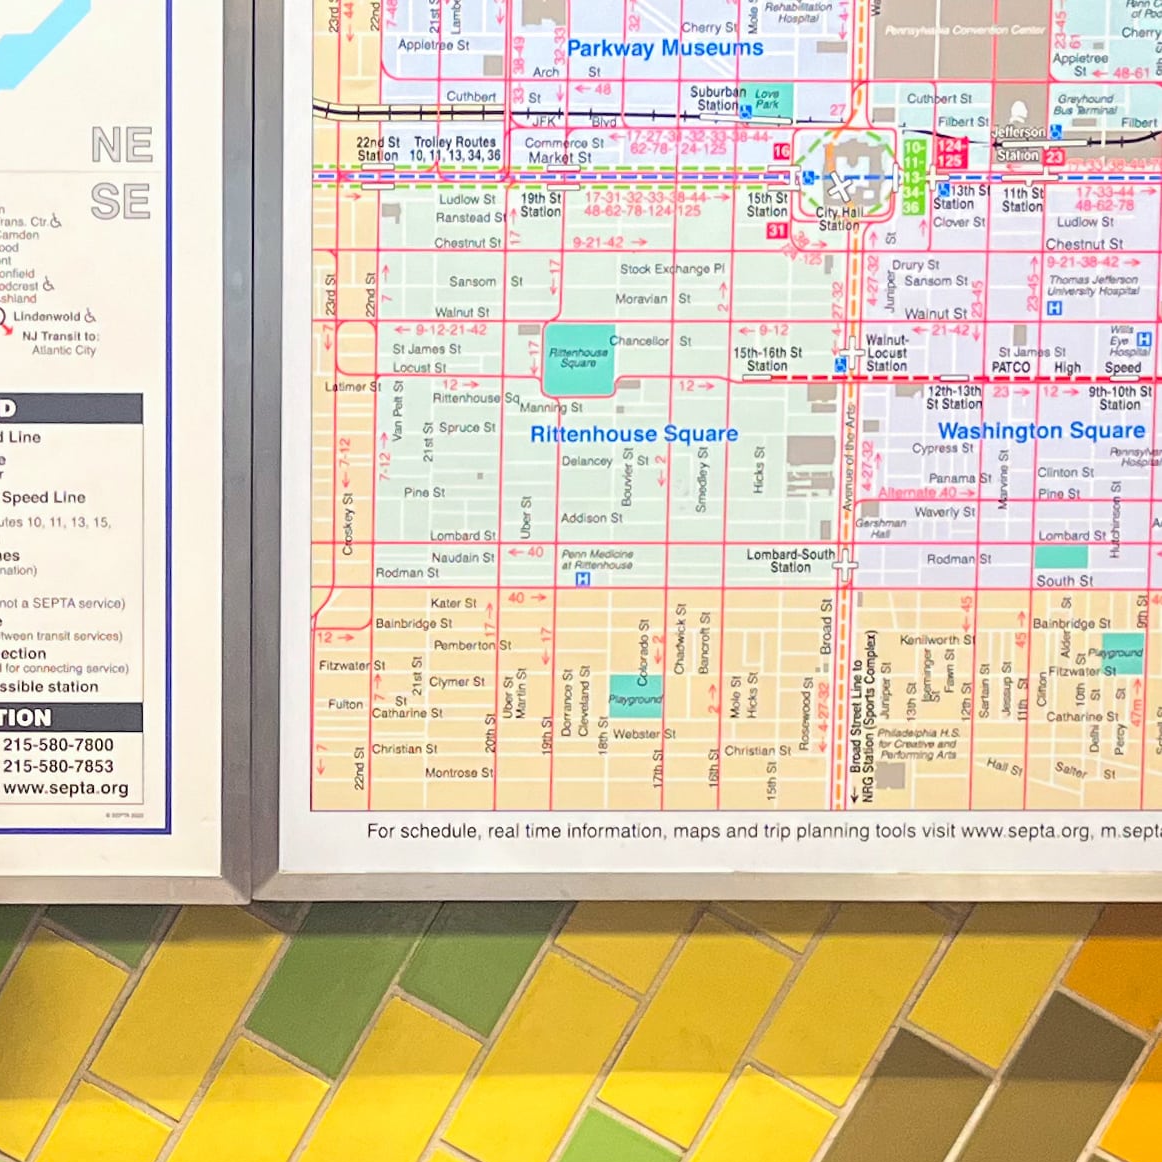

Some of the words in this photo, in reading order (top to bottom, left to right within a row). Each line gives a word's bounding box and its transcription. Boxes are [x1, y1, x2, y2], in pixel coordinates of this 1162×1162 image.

[568, 38, 655, 58] Parkway
[661, 38, 764, 56] Museums
[91, 126, 153, 163] NE
[357, 137, 384, 148] 22nd
[388, 136, 400, 148] St
[414, 135, 452, 151] Trolley
[456, 136, 496, 148] Routes
[358, 150, 398, 161] Station
[410, 149, 425, 162] 10,
[430, 149, 445, 162] 11,
[449, 149, 465, 162] 13,
[468, 149, 484, 162] 34,
[488, 149, 500, 161] 36
[775, 143, 792, 158] 16
[90, 182, 151, 220] SE
[522, 192, 545, 204] 19th
[550, 192, 561, 204] St
[748, 191, 772, 204] 15th
[775, 191, 787, 204] St
[521, 205, 561, 217] Station
[747, 205, 787, 217] Station
[814, 205, 838, 220] City
[842, 207, 864, 218] Hall
[819, 219, 859, 231] Station
[14, 312, 80, 321] Lindenwold
[23, 331, 37, 341] NJ
[41, 331, 80, 341] Transit
[84, 331, 101, 342] to:
[734, 347, 786, 358] 15th-16th
[790, 346, 802, 358] St
[748, 360, 787, 371] Station
[9, 431, 41, 443] Line
[531, 425, 656, 443] Rittenhouse
[664, 425, 738, 444] Square
[938, 422, 1063, 442] Washington
[1069, 422, 1146, 441] Square
[3, 491, 48, 506] Speed
[54, 491, 85, 503] Line
[28, 517, 45, 528] 10,
[50, 517, 66, 528] 11,
[72, 517, 88, 528] 13,
[94, 517, 111, 528] 15,
[747, 548, 835, 560] Lombard-South
[771, 561, 811, 573] Station
[22, 600, 29, 608] a
[33, 597, 76, 608] SEPTA
[79, 598, 125, 610] service)
[862, 630, 878, 684] Complex)
[850, 660, 862, 668] to
[49, 681, 98, 692] station
[850, 671, 862, 696] Line
[862, 687, 878, 730] (Sports
[850, 699, 862, 736] Street
[4, 738, 113, 751] 215-580-7800
[862, 731, 874, 769] Station
[850, 738, 862, 773] Broad
[4, 760, 113, 773] 215-580-7853
[4, 782, 128, 798] www.septa.org
[862, 776, 874, 803] NRG
[368, 823, 395, 838] For
[401, 823, 481, 840] schedule,
[489, 824, 519, 838] real
[526, 824, 561, 838] time
[568, 823, 666, 839] information,
[674, 827, 720, 841] maps
[727, 824, 757, 838] and
[764, 824, 790, 841] trip
[797, 823, 869, 842] planning
[876, 823, 916, 838] tools
[922, 824, 955, 838] visit
[962, 824, 1093, 842] www.septa.org,
[1101, 823, 1162, 842] m.sept
